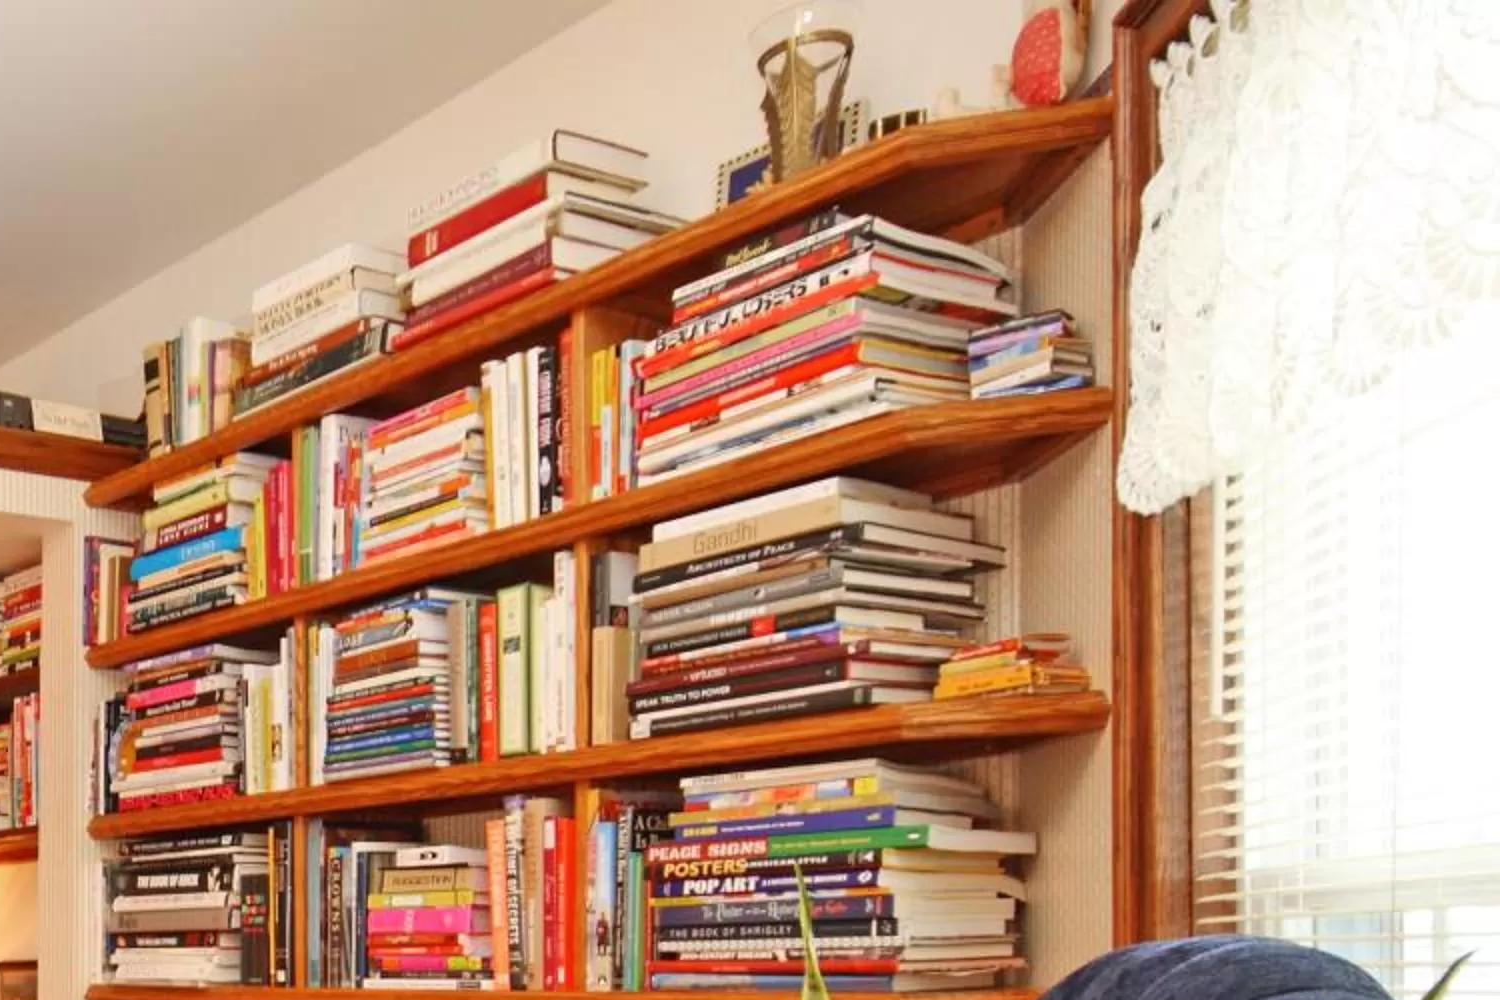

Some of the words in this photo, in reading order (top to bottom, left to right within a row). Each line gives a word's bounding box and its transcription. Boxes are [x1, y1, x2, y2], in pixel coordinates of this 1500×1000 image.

[693, 519, 758, 555] Gandhi
[686, 554, 747, 573] ARCHITECTS
[763, 541, 795, 557] PEACE
[635, 694, 659, 709] SPEAK
[660, 691, 687, 706] TRUTH
[688, 689, 700, 700] TO
[701, 684, 731, 699] POWER
[649, 844, 702, 861] PEACE
[707, 839, 768, 857] SIGNS
[663, 859, 747, 878] POSTERS
[683, 878, 721, 896] POP
[722, 876, 760, 892] ART
[669, 927, 687, 938] THE
[692, 926, 718, 937] BOOK
[723, 926, 736, 936] OF
